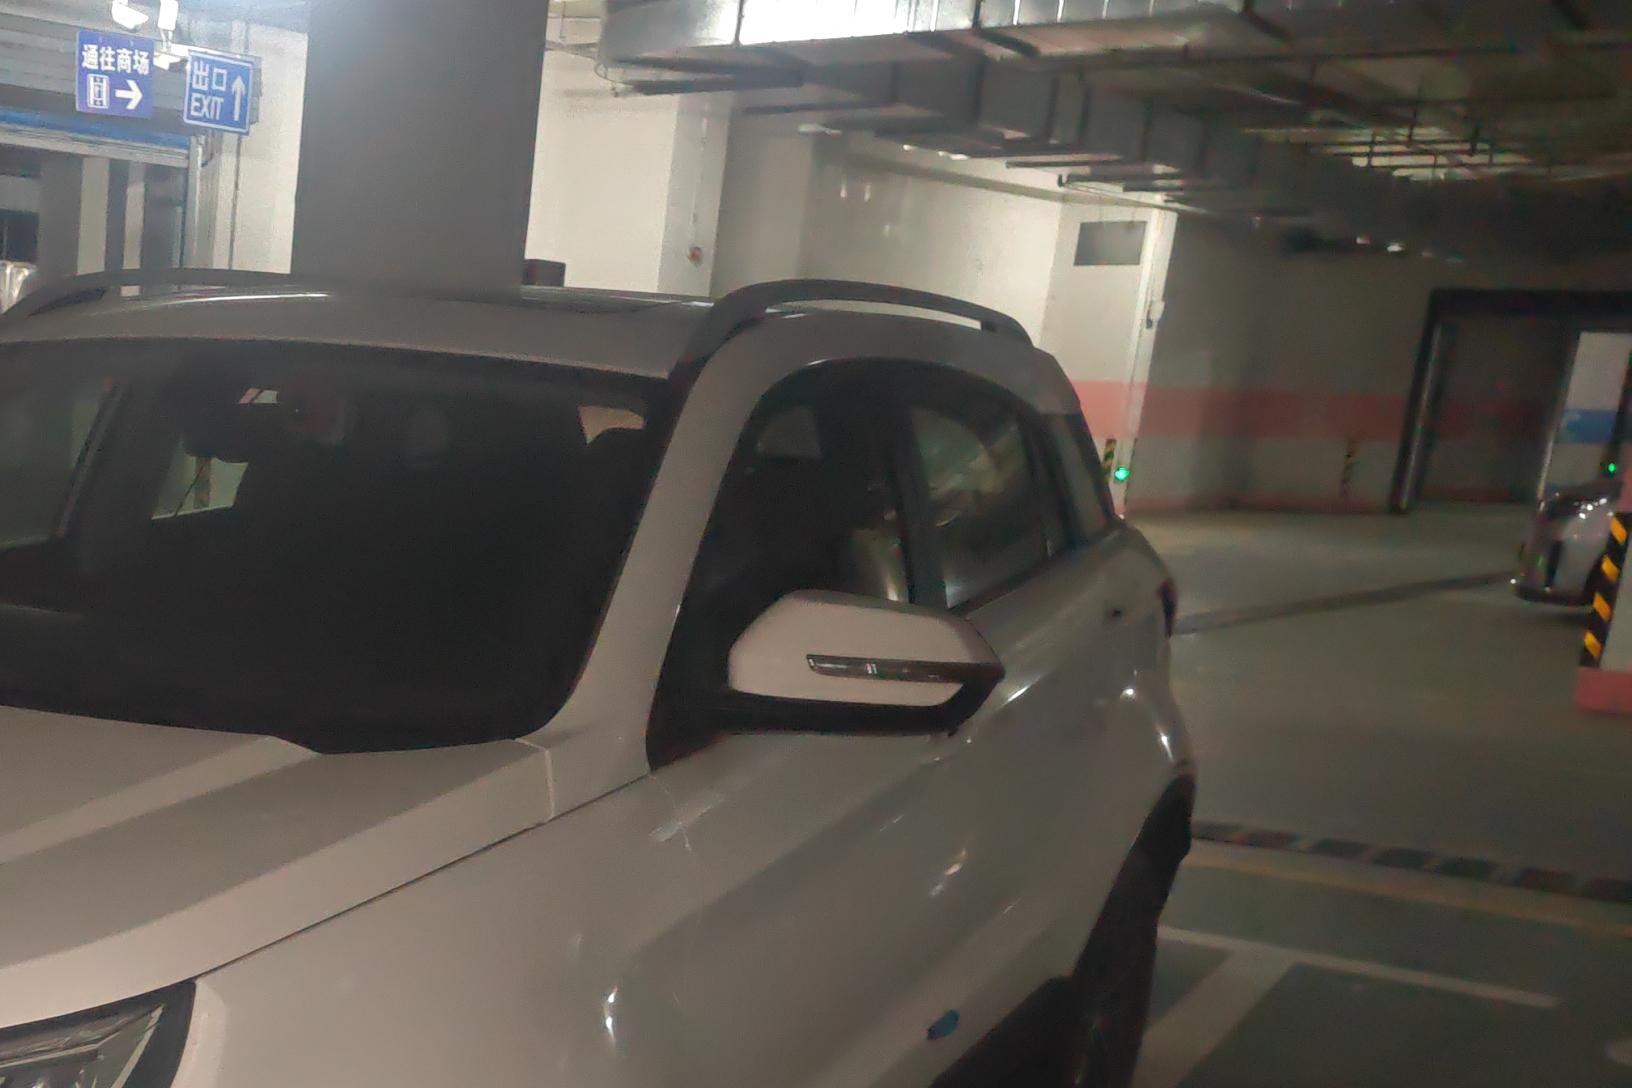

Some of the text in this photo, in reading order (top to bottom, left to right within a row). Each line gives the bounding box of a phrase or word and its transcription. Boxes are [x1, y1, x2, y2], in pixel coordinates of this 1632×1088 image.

[82, 44, 150, 75] 通往商场
[191, 60, 228, 92] 出口
[190, 93, 224, 120] EXIT
